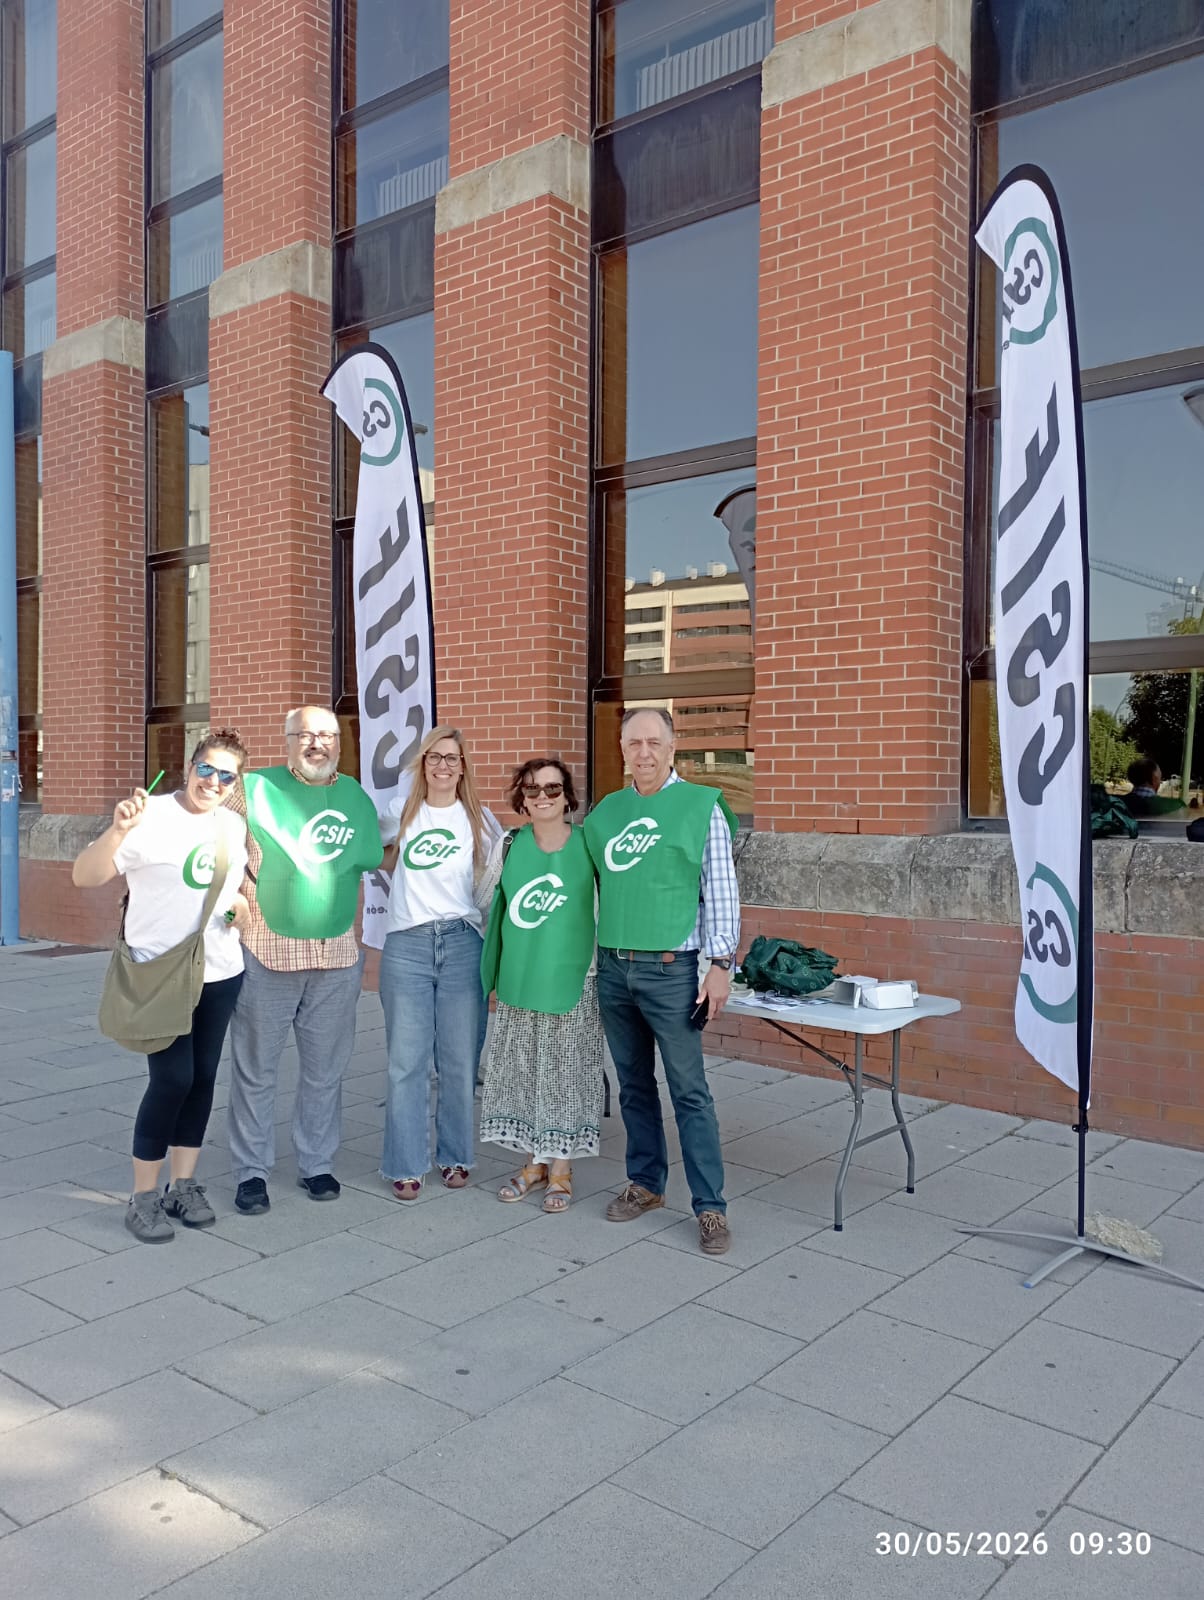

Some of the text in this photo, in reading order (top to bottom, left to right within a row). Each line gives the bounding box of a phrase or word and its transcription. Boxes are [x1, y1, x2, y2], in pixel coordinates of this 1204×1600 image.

[311, 824, 355, 845] CSIF
[615, 833, 662, 853] CSIF
[414, 839, 461, 858] CSIF
[523, 889, 568, 912] CSIF
